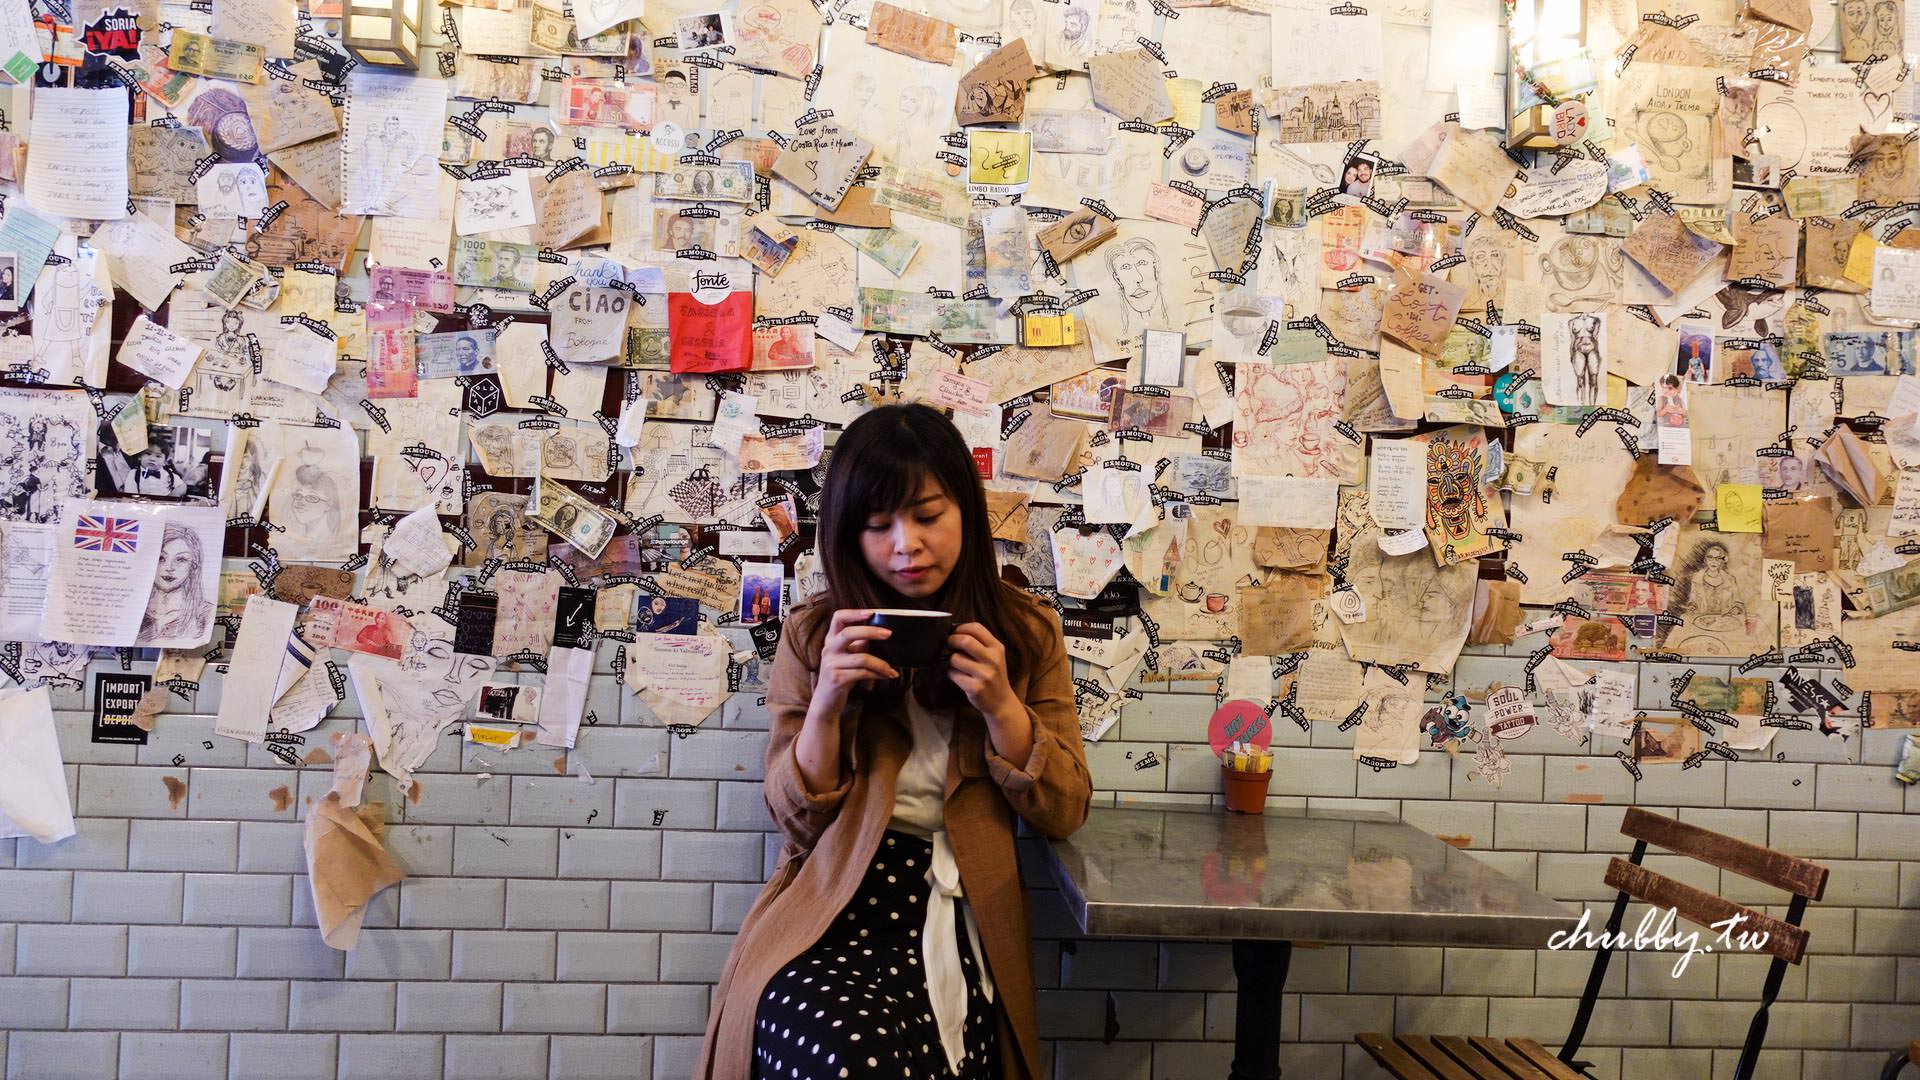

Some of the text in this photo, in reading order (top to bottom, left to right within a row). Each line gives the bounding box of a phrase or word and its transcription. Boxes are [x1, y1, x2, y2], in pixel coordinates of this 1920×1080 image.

[105, 18, 136, 30] SORIA
[1644, 15, 1677, 24] EXMOUTH
[685, 57, 723, 68] EXMOUTH
[110, 62, 141, 93] EXMOUTH
[806, 65, 822, 100] EXMOUTH
[1656, 84, 1691, 99] LONDON
[796, 110, 832, 126] EXMOUTH
[1556, 112, 1565, 138] BIRD
[1566, 108, 1576, 138] LADY
[449, 118, 485, 140] EXMOUTH
[1119, 122, 1156, 132] EXMOUTH
[1159, 128, 1193, 136] EXMOUTH
[707, 130, 742, 150] EXMOUTH
[812, 138, 828, 152] Rica
[504, 159, 543, 167] EXMOUTH
[681, 156, 719, 164] EXMOUTH
[189, 153, 219, 183] EXMOUTH
[472, 169, 510, 179] EXMOUTH
[547, 158, 580, 180] EXMOUTH
[968, 185, 1010, 194] LIMBO RADIO
[1170, 182, 1205, 198] EXMOUTH
[1307, 189, 1339, 206] EXMOUTH
[681, 209, 719, 217] EXMOUTH
[1081, 198, 1114, 221] EXMOUTH
[1330, 208, 1344, 217] 100
[1413, 212, 1446, 221] EXMOUTH
[463, 240, 486, 250] 1000
[678, 250, 716, 259] EXMOUTH
[171, 264, 214, 272] EXMOUTH
[295, 264, 334, 273] EXMOUTH
[1431, 257, 1464, 271] EXMOUTH
[692, 270, 730, 293] fonte
[1210, 272, 1244, 282] EXMOUTH
[1337, 276, 1373, 287] EXMOUTH
[542, 278, 574, 301] EXMOUTH
[302, 318, 336, 340] EXMOUTH
[1458, 320, 1490, 337] EXMOUTH
[1259, 322, 1277, 354] EXMOUTH
[1725, 341, 1758, 349] EXMOUTH
[542, 341, 570, 374] EXMOUTH
[967, 348, 1000, 362] EXMOUTH
[1838, 356, 1846, 369] 5
[1506, 371, 1534, 394] EXMOUTH
[1438, 390, 1472, 398] EXMOUTH
[530, 397, 566, 416] EXMOUTH
[361, 401, 390, 432] EXMOUTH
[1607, 410, 1640, 426] EXMOUTH
[520, 421, 559, 429] EXMOUTH
[790, 420, 825, 428] EXMOUTH
[1002, 411, 1030, 438] EXMOUTH
[1184, 424, 1218, 437] EXMOUTH
[767, 429, 802, 438] EXMOUTH
[1116, 431, 1152, 440] EXMOUTH
[1617, 428, 1639, 458] EXMOUTH
[1104, 461, 1140, 470] EXMOUTH
[776, 479, 806, 500] EXMOUTH
[1185, 496, 1220, 504] EXMOUTH
[446, 524, 476, 549] EXMOUTH
[629, 540, 635, 550] 5
[682, 546, 714, 569] EXMOUTH
[1564, 553, 1597, 563] EXMOUTH
[506, 563, 545, 571] EXMOUTH
[552, 557, 579, 586] EXMOUTH
[629, 578, 665, 595] EXMOUTH
[314, 600, 338, 611] 100
[1064, 622, 1112, 631] COFFEE AGAINST
[1140, 611, 1158, 646] EXMOUTH
[1525, 647, 1553, 671] EXMOUTH
[326, 661, 344, 699] EXMOUTH
[106, 683, 140, 694] IMPORT
[1075, 680, 1108, 700] EXMOUTH
[105, 699, 138, 710] EXPORT
[1494, 694, 1519, 708] SOUL
[1281, 702, 1309, 730] EXMOUTH
[1342, 702, 1368, 730] EXMOUTH
[1494, 704, 1522, 718] POWER
[104, 714, 134, 726] DEPOR
[1499, 718, 1525, 732] TATTOO
[1704, 713, 1738, 725] EXMOUTH
[265, 732, 304, 744] EXMOUTH
[1706, 744, 1738, 760] EXMOUTH
[1361, 756, 1396, 768] EXMOUTH
